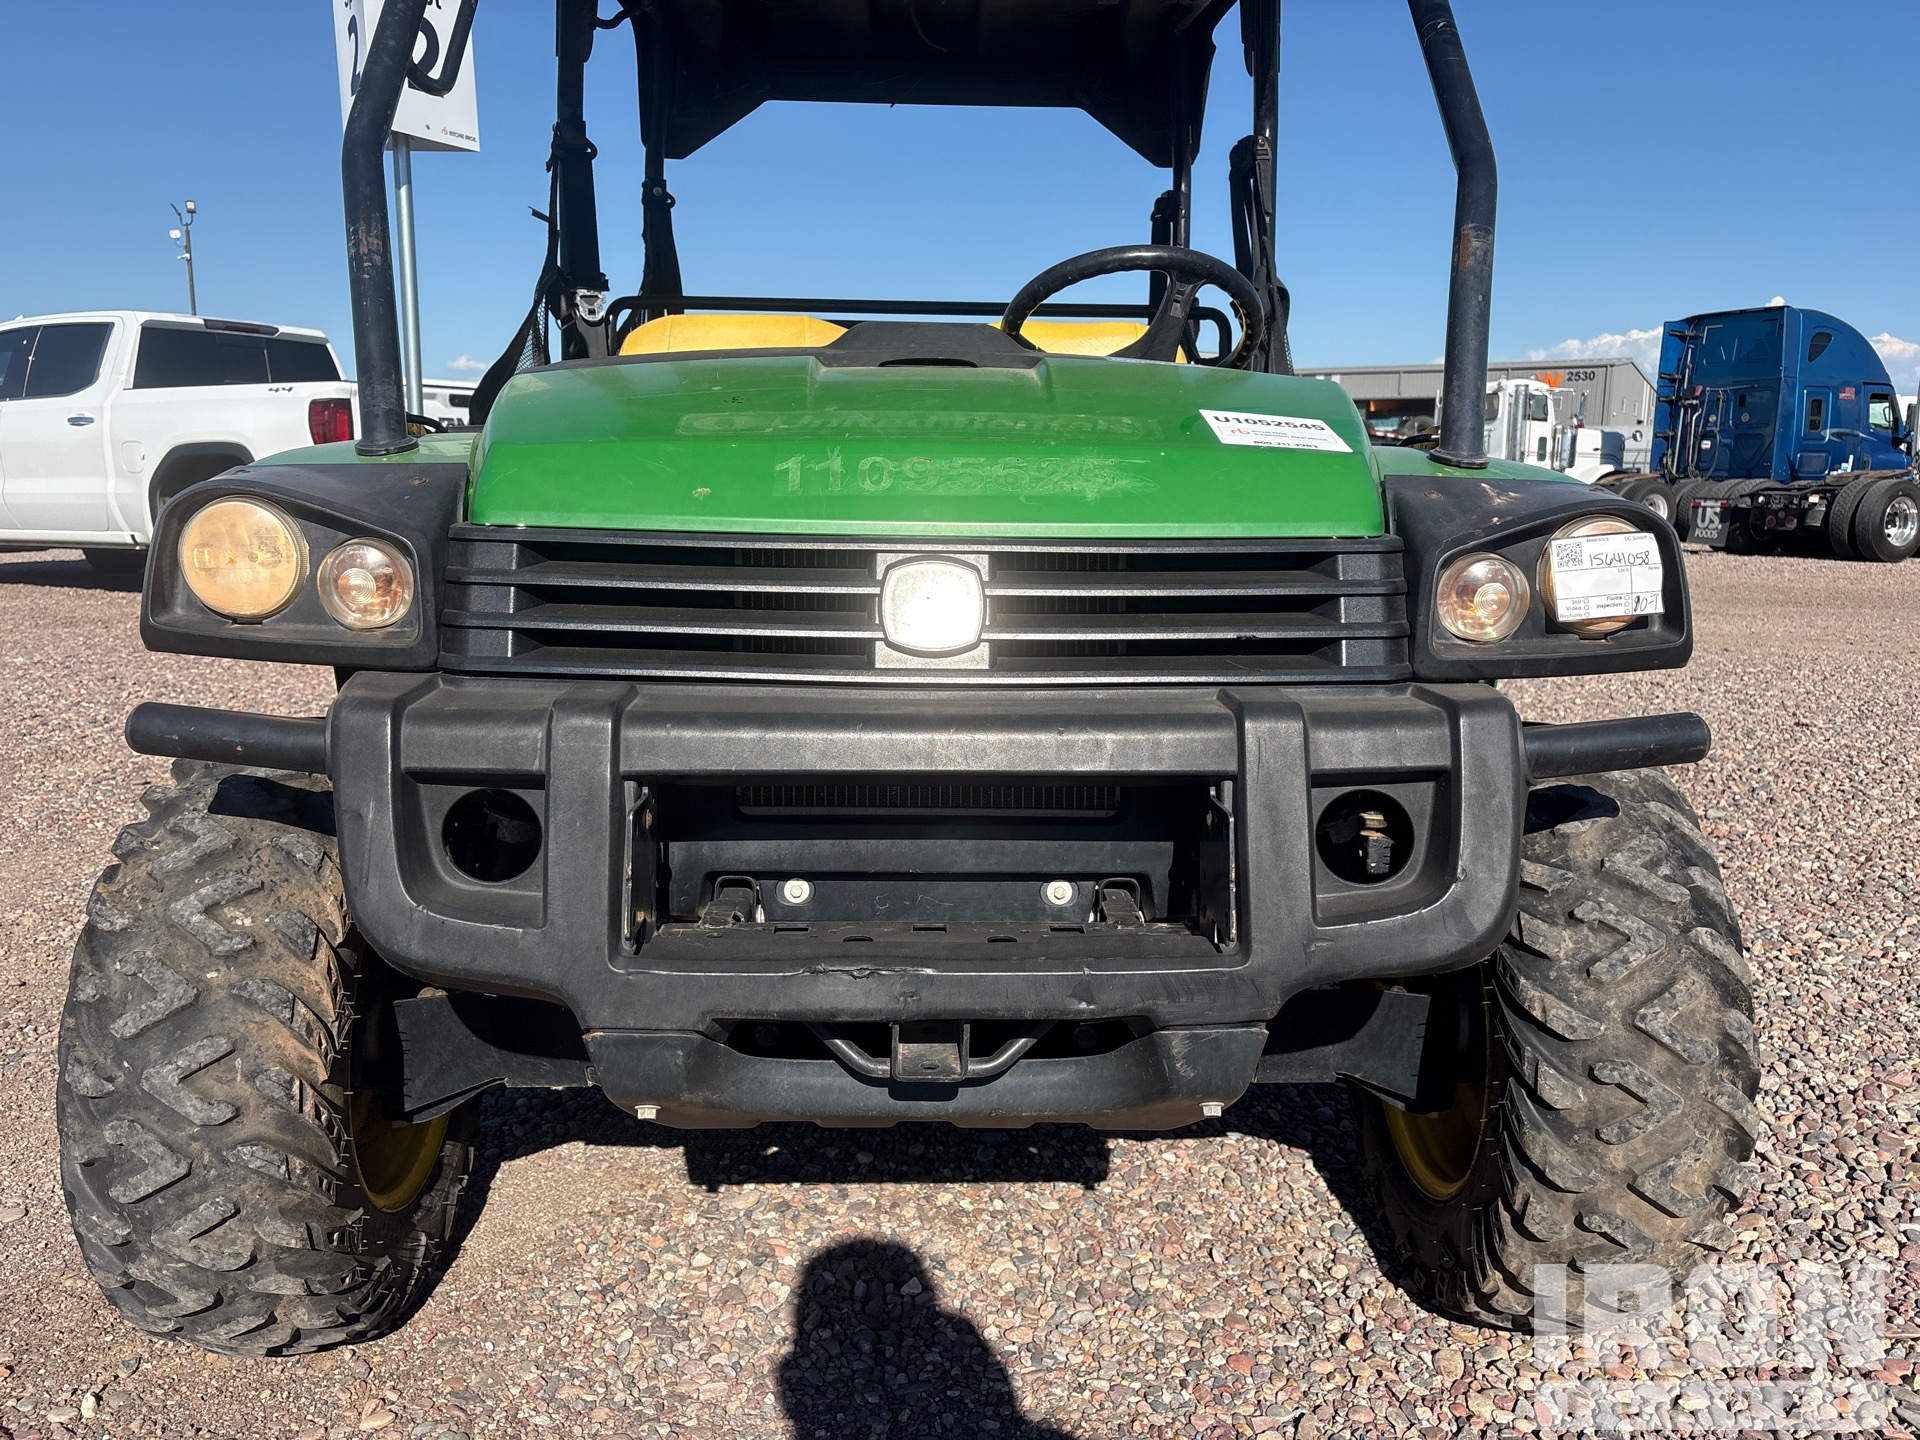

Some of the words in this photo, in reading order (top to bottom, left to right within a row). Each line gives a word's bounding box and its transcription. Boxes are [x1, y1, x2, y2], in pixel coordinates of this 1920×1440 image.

[1566, 371, 1596, 382] 2530
[1213, 415, 1326, 432] U1052545
[1589, 550, 1650, 567] 15641058
